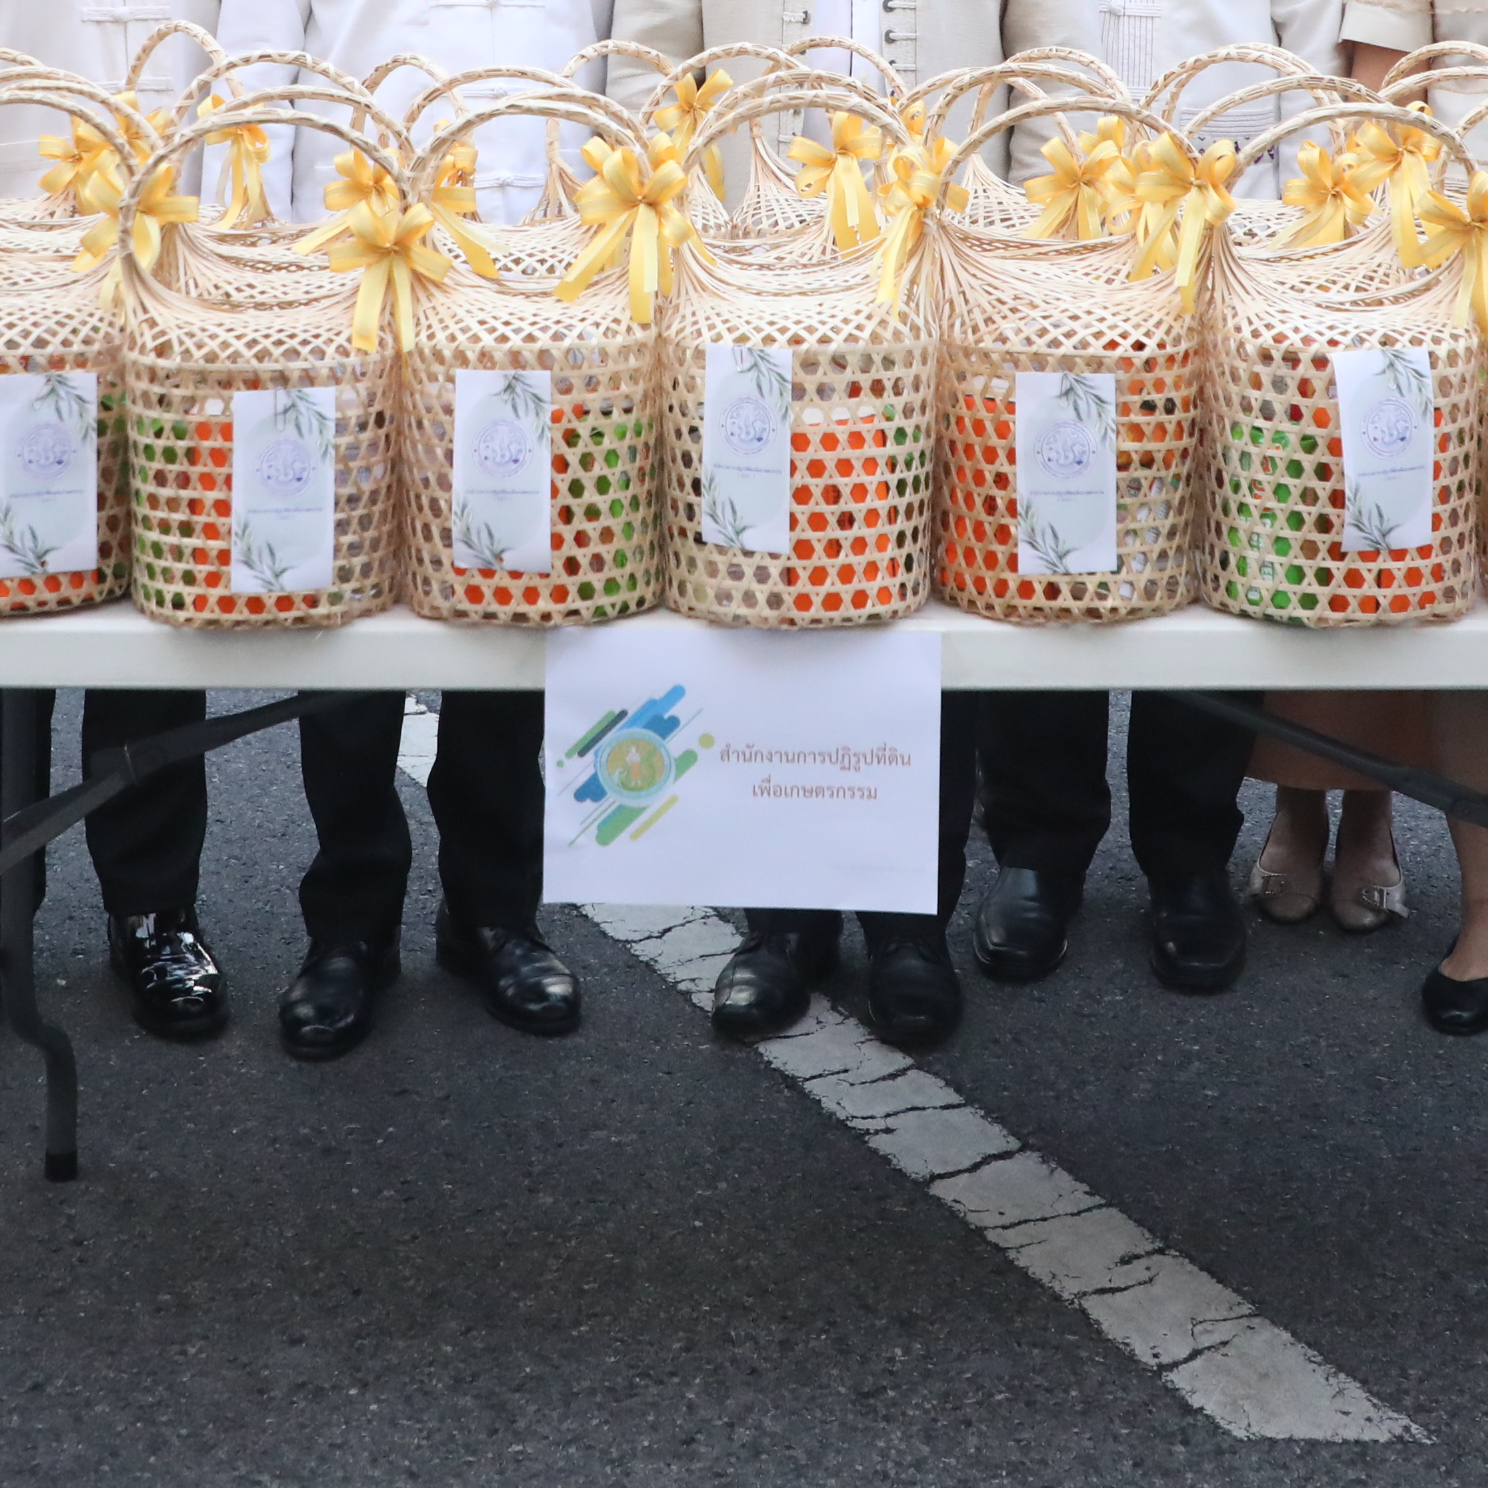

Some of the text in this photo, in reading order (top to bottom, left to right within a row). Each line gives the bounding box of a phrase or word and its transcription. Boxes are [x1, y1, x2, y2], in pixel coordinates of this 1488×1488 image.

[719, 742, 912, 773] สำนักงานการปฏิรูปที่ดิน
[752, 773, 878, 800] เพื่อเกษตรกรรม
